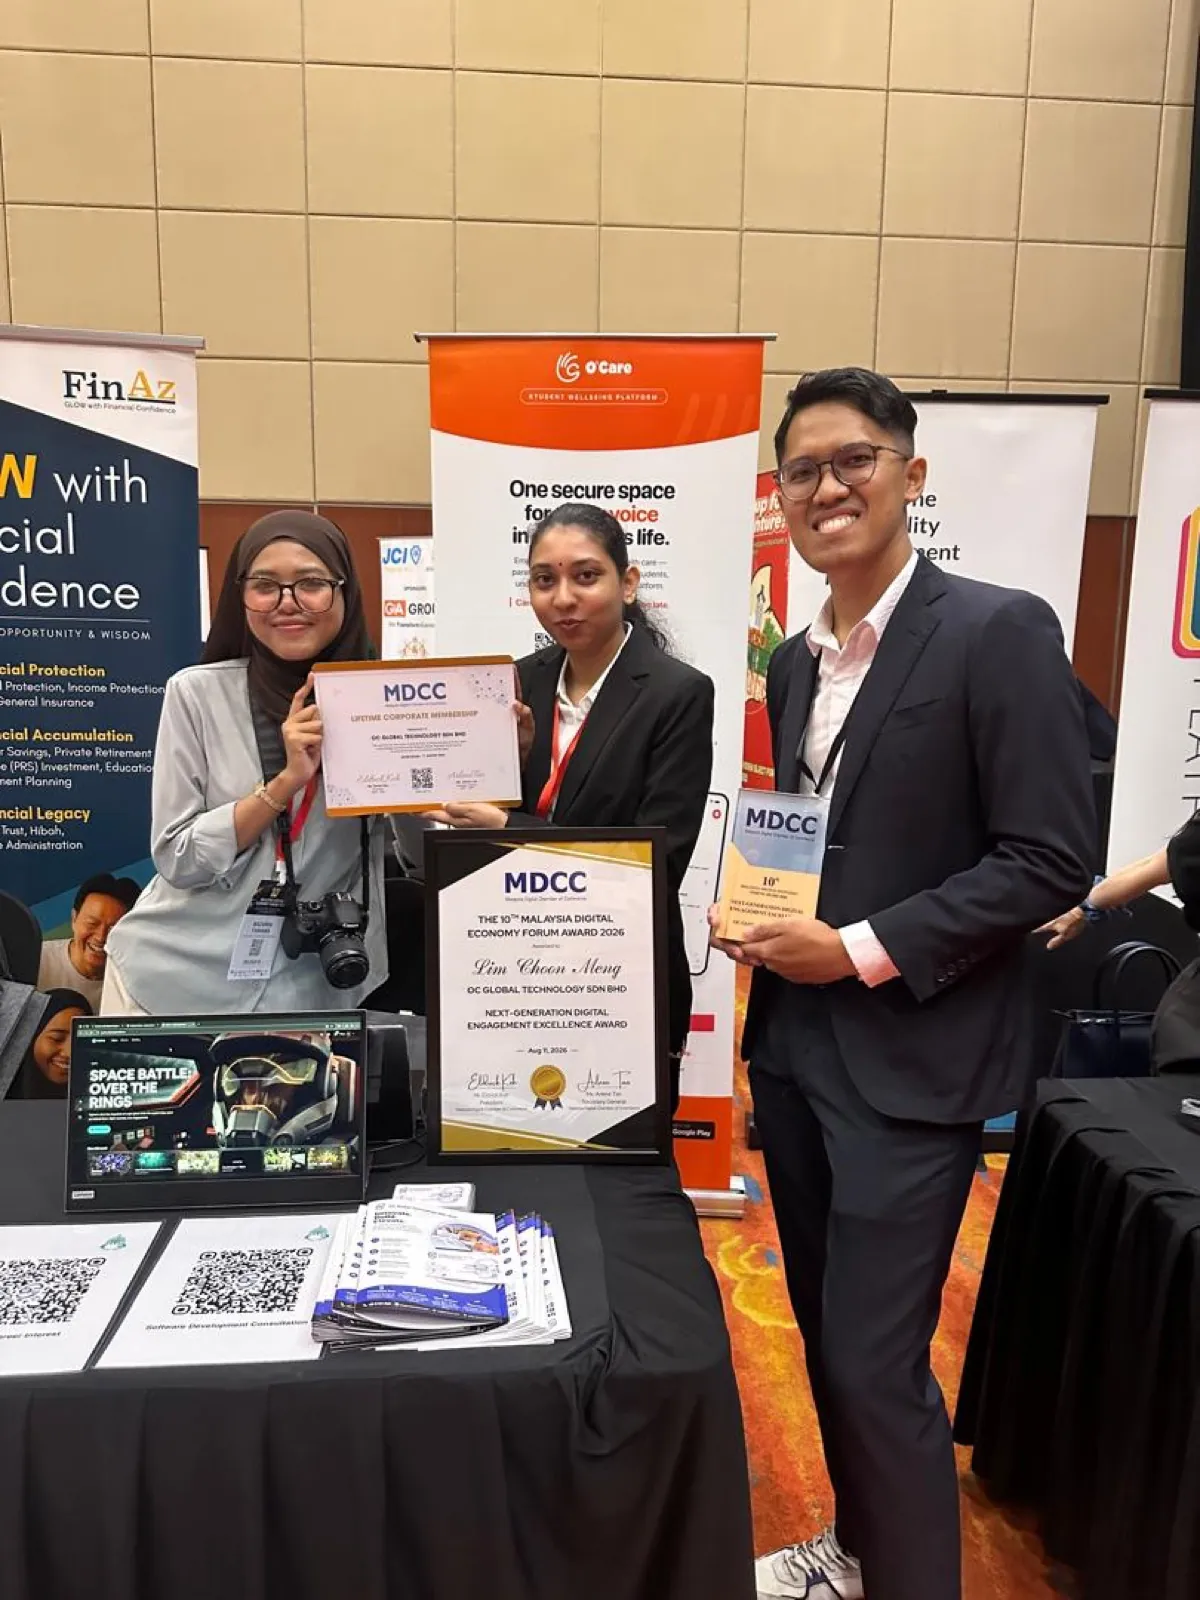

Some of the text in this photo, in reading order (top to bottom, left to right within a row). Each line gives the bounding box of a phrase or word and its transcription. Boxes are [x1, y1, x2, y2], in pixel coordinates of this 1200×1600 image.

[585, 360, 633, 375] O'Care
[62, 369, 176, 401] FinAz
[528, 393, 565, 401] STUDENT
[103, 403, 134, 411] Financial
[135, 405, 176, 414] Confidence
[53, 459, 147, 503] with
[509, 480, 675, 502] One secure space
[610, 505, 659, 522] voice
[907, 515, 941, 538] lity
[636, 529, 670, 546] life.
[382, 547, 408, 565] JCI
[1, 564, 141, 609] dence
[88, 630, 96, 639] &
[101, 630, 151, 641] WISDOM
[29, 663, 106, 678] Protection
[5, 680, 65, 693] Protection,
[67, 682, 108, 694] Income
[384, 683, 447, 702] MDCC
[41, 696, 94, 709] Insurance
[383, 712, 429, 721] CORPORATE
[0, 727, 134, 743] cial Accumulation
[6, 746, 51, 760] Savings,
[54, 746, 92, 757] Private
[95, 747, 152, 758] Retirement
[10, 761, 39, 774] (PRS)
[41, 762, 103, 773] Investment,
[105, 761, 154, 773] Educatio
[25, 776, 72, 789] Planning
[37, 807, 91, 823] Legacy
[746, 807, 817, 835] MDCC
[2, 825, 65, 837] Trust, Hibah,
[6, 840, 84, 851] Administration
[504, 871, 587, 893] MDCC
[478, 915, 498, 923] THE
[521, 914, 573, 923] MALAYSIA
[574, 914, 613, 923] DIGITAL
[467, 928, 625, 938] ECONOMY FORUM AWARD 2026
[472, 956, 622, 980] Lim Choon Meng
[467, 985, 627, 994] OC GLOBAL TECHNOLOGY SDN BHD
[485, 1008, 609, 1017] NEXT-GENERATION DIGITAL
[467, 1020, 628, 1030] ENGAGEMENT EXCELLENCE AWARD
[89, 1069, 135, 1081] SPACE
[89, 1082, 158, 1095] OVER THE
[88, 1096, 133, 1109] RINGS
[188, 1321, 249, 1330] Development
